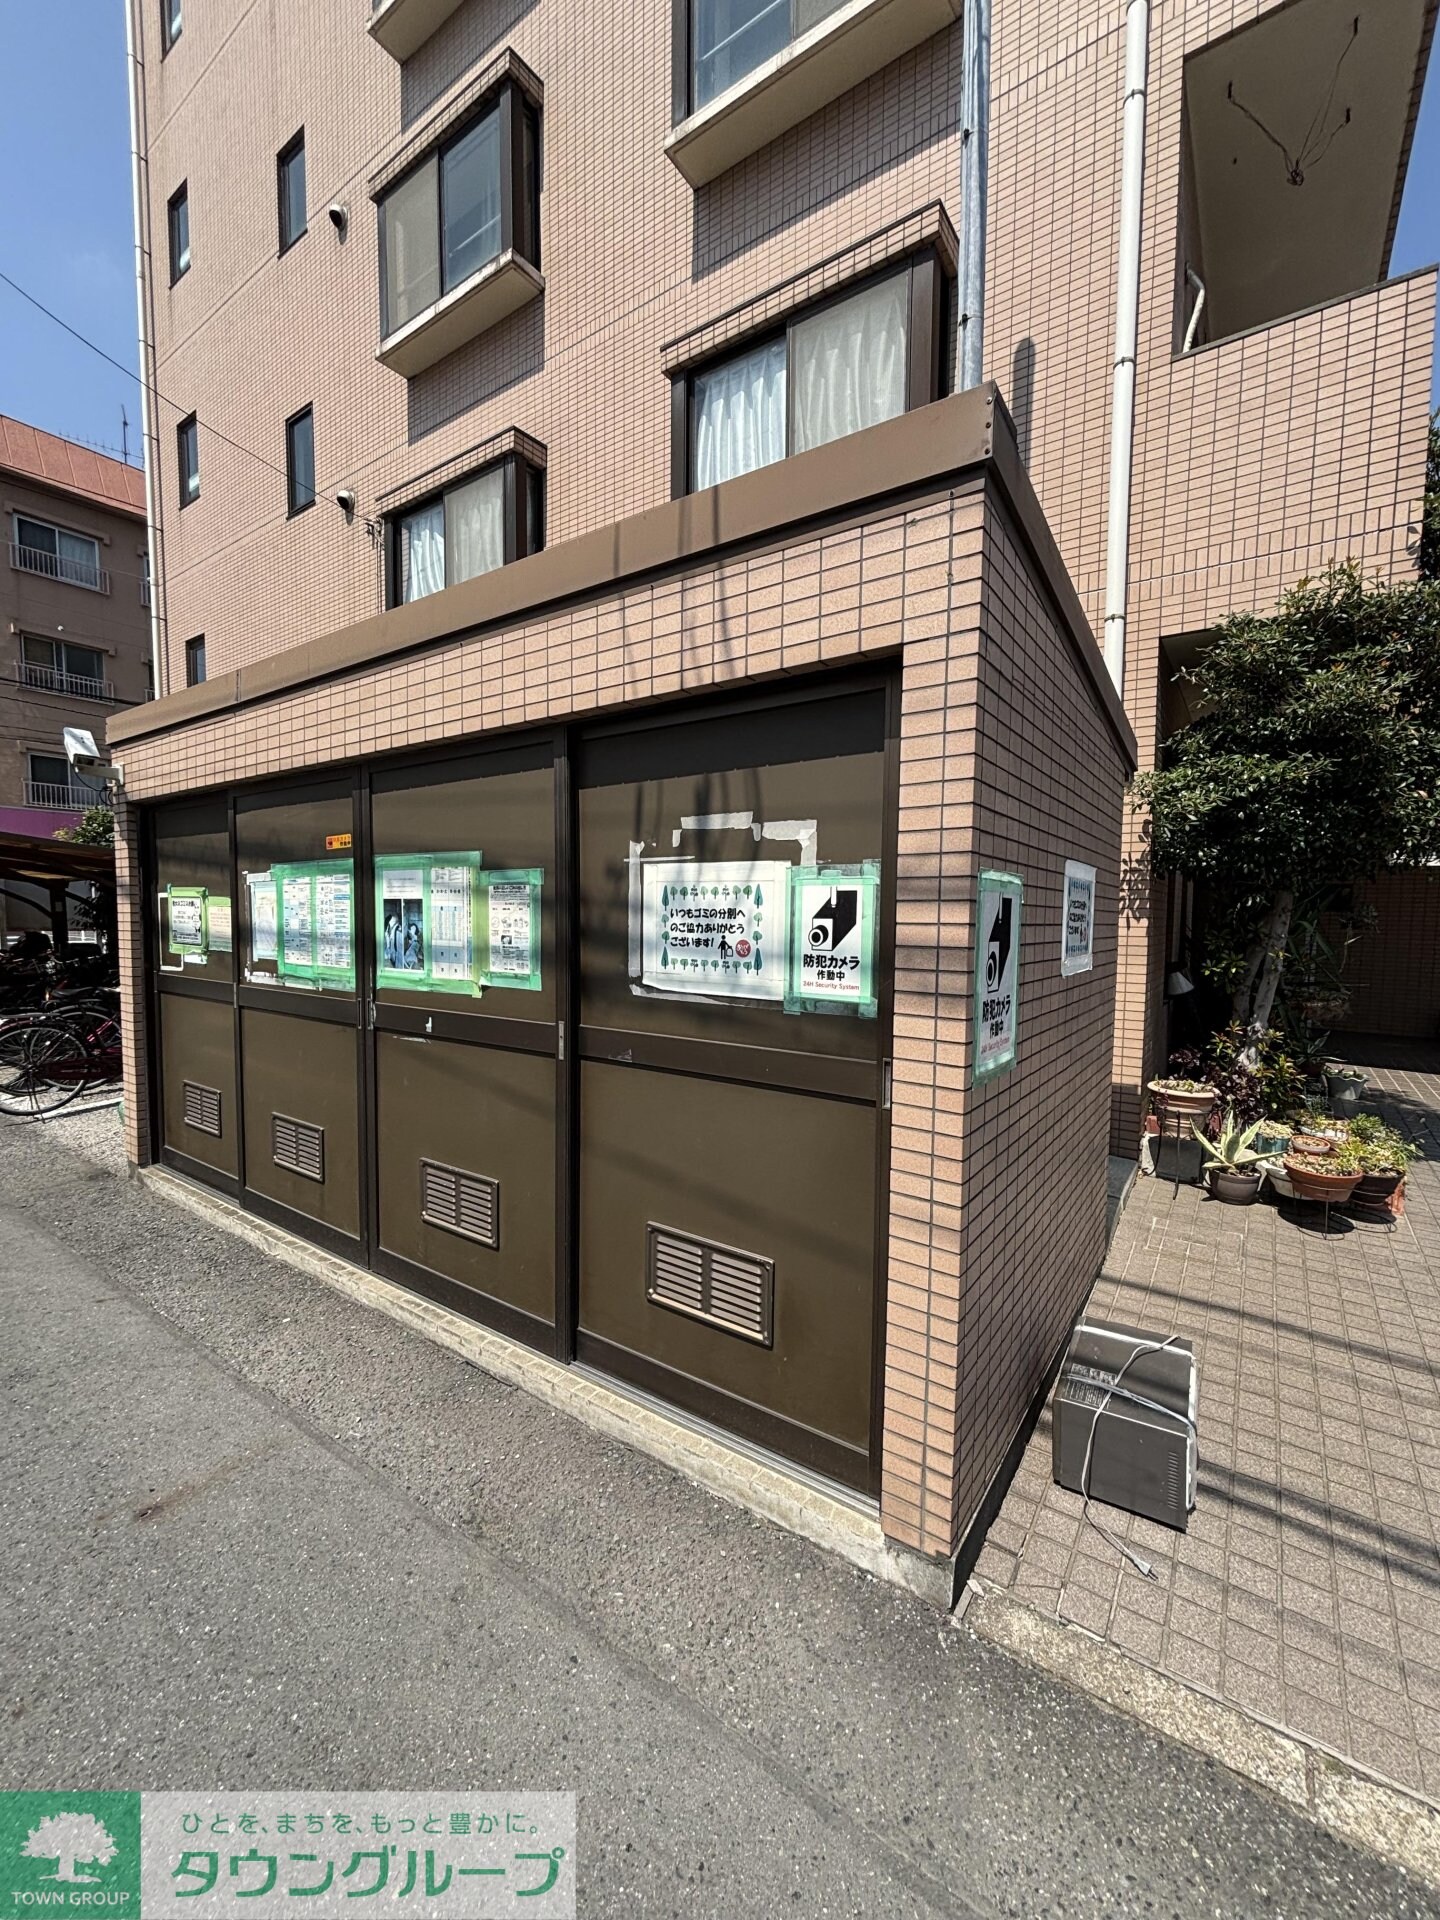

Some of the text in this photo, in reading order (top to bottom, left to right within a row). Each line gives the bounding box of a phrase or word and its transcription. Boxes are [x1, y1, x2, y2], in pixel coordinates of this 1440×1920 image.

[670, 908, 746, 919] いつもゴミの分別へ
[670, 922, 745, 934] のご協力ありがとう
[803, 954, 860, 970] 防犯カメラ
[817, 970, 845, 981] 作動中
[815, 981, 837, 990] Security
[982, 994, 1011, 1024] 防犯カメラ
